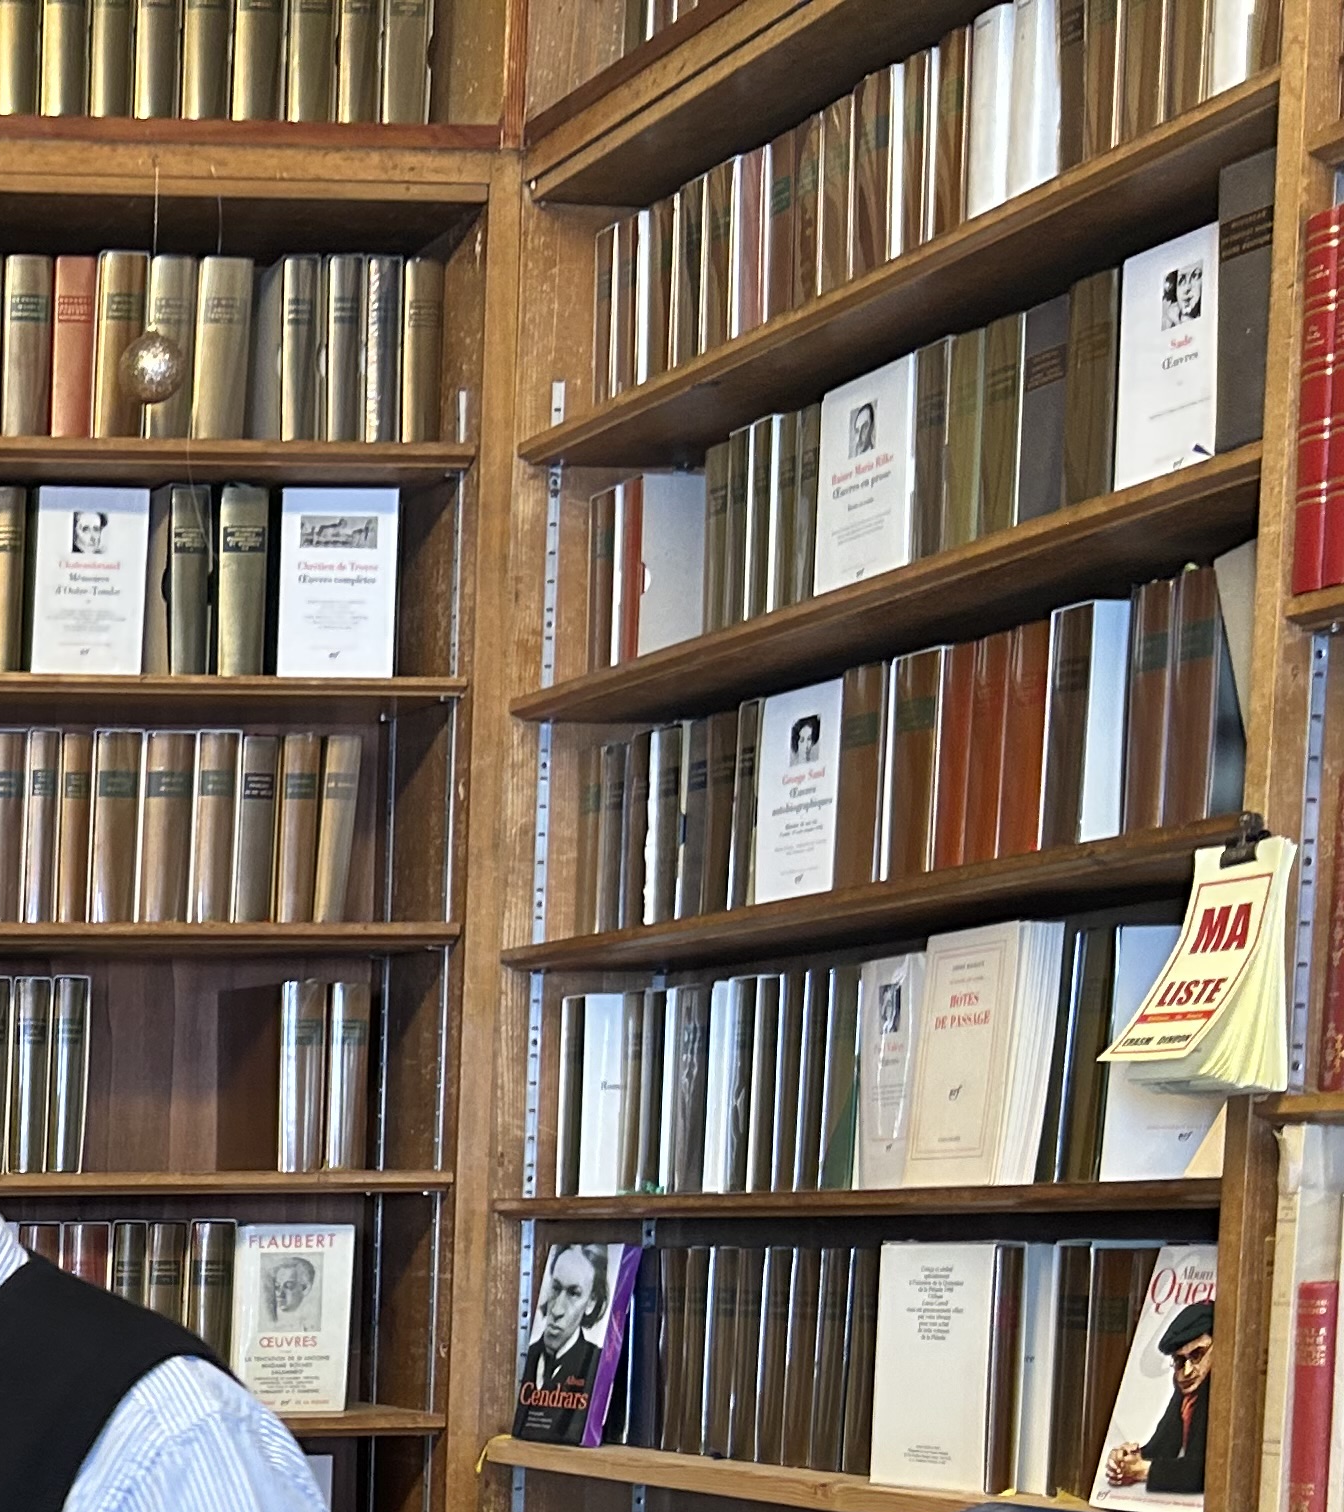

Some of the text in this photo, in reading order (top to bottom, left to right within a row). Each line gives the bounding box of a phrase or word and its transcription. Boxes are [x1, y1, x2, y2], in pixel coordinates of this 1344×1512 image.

[1170, 334, 1194, 350] Sade
[1162, 350, 1199, 371] Œuvres
[297, 560, 334, 571] Chrétien
[297, 573, 377, 587] Œuvres complètes
[782, 766, 826, 786] George Sand
[789, 786, 817, 799] Œuvres
[1188, 901, 1254, 956] MA
[949, 990, 980, 1010] HÔTES
[1155, 976, 1229, 1008] LISTE
[934, 1009, 992, 1031] DE PASSAGE
[1121, 1036, 1156, 1048] ERASM
[948, 1084, 964, 1101] nrf
[248, 1232, 337, 1250] FLAUBERT
[1179, 1265, 1214, 1280] Album
[258, 1334, 318, 1350] ŒUVRES
[519, 1381, 589, 1411] Cendrars
